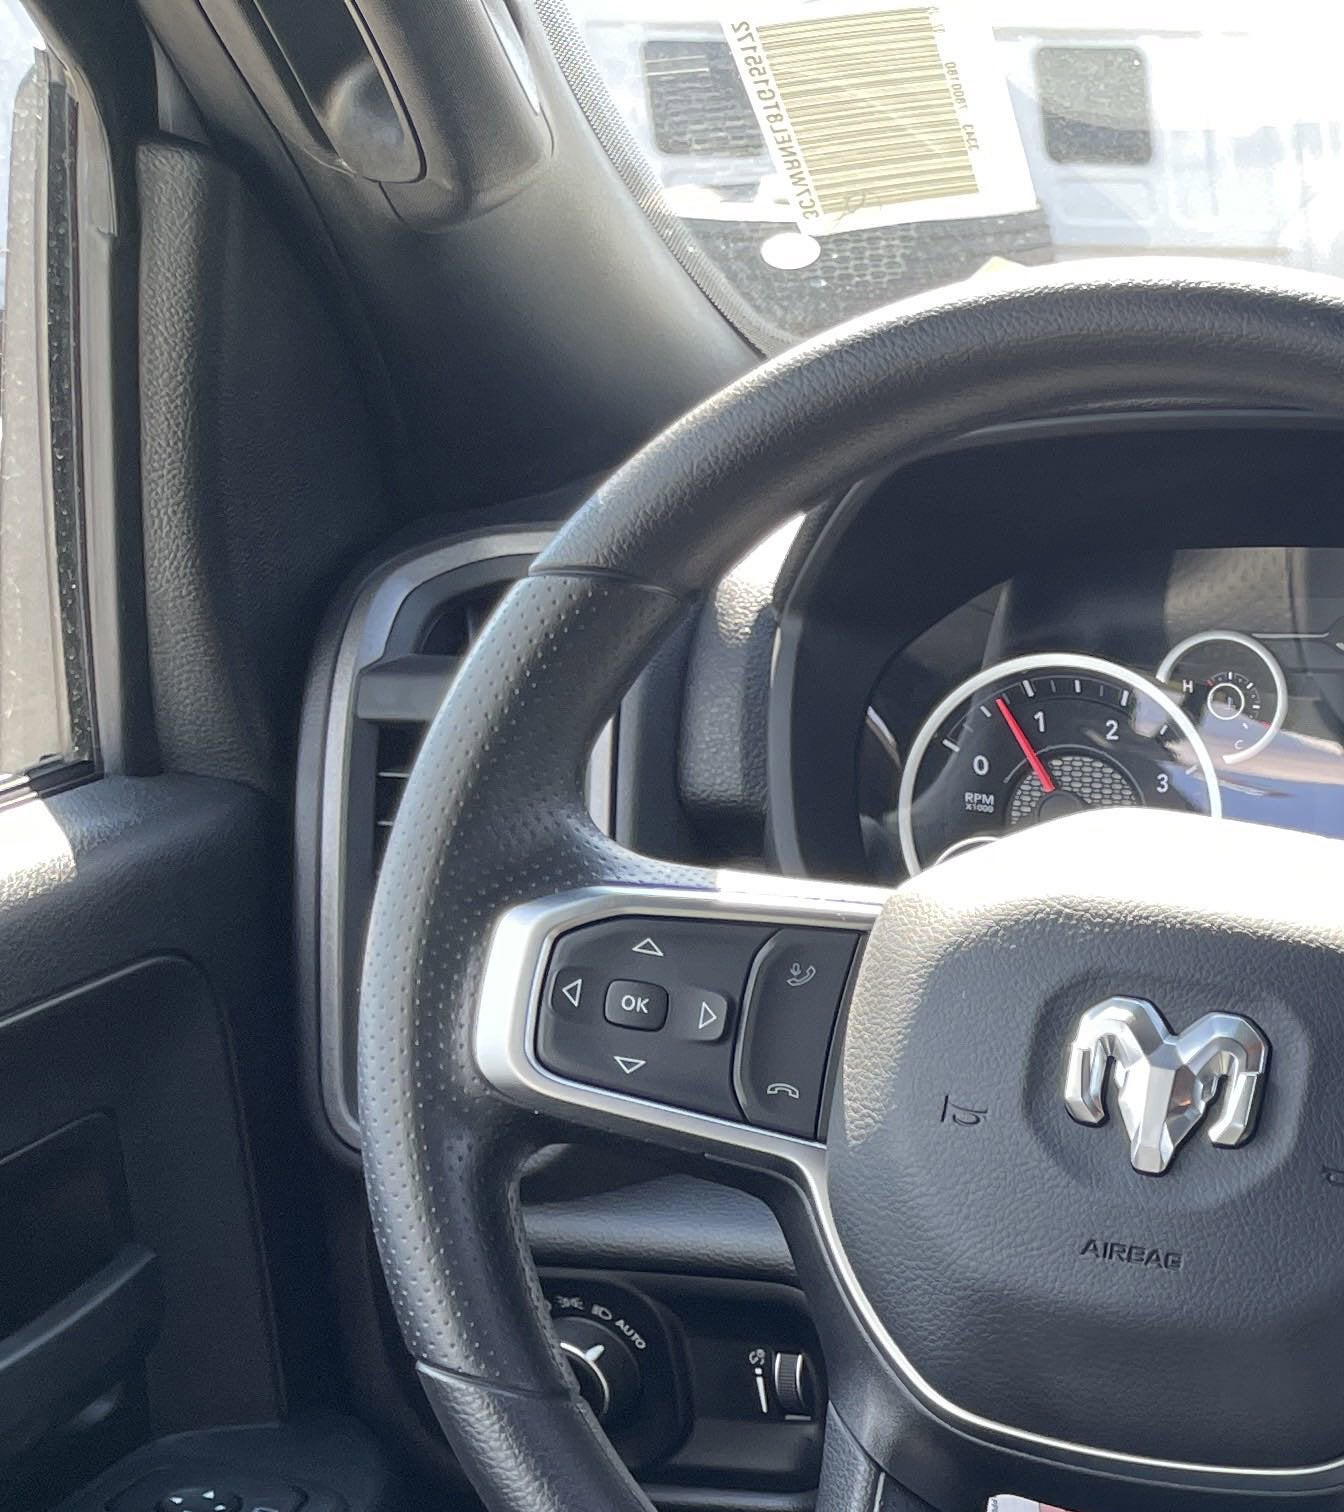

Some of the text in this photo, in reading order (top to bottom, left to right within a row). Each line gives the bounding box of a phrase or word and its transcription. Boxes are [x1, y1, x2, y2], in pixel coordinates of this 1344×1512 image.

[1183, 680, 1193, 693] H
[1034, 711, 1045, 732] 1
[1106, 720, 1119, 740] 2
[973, 755, 989, 775] 0
[1156, 774, 1169, 793] 3
[964, 792, 994, 805] RPM
[621, 994, 649, 1014] OK
[1080, 1238, 1184, 1271] AIRBAG
[615, 1319, 646, 1350] AUTO
